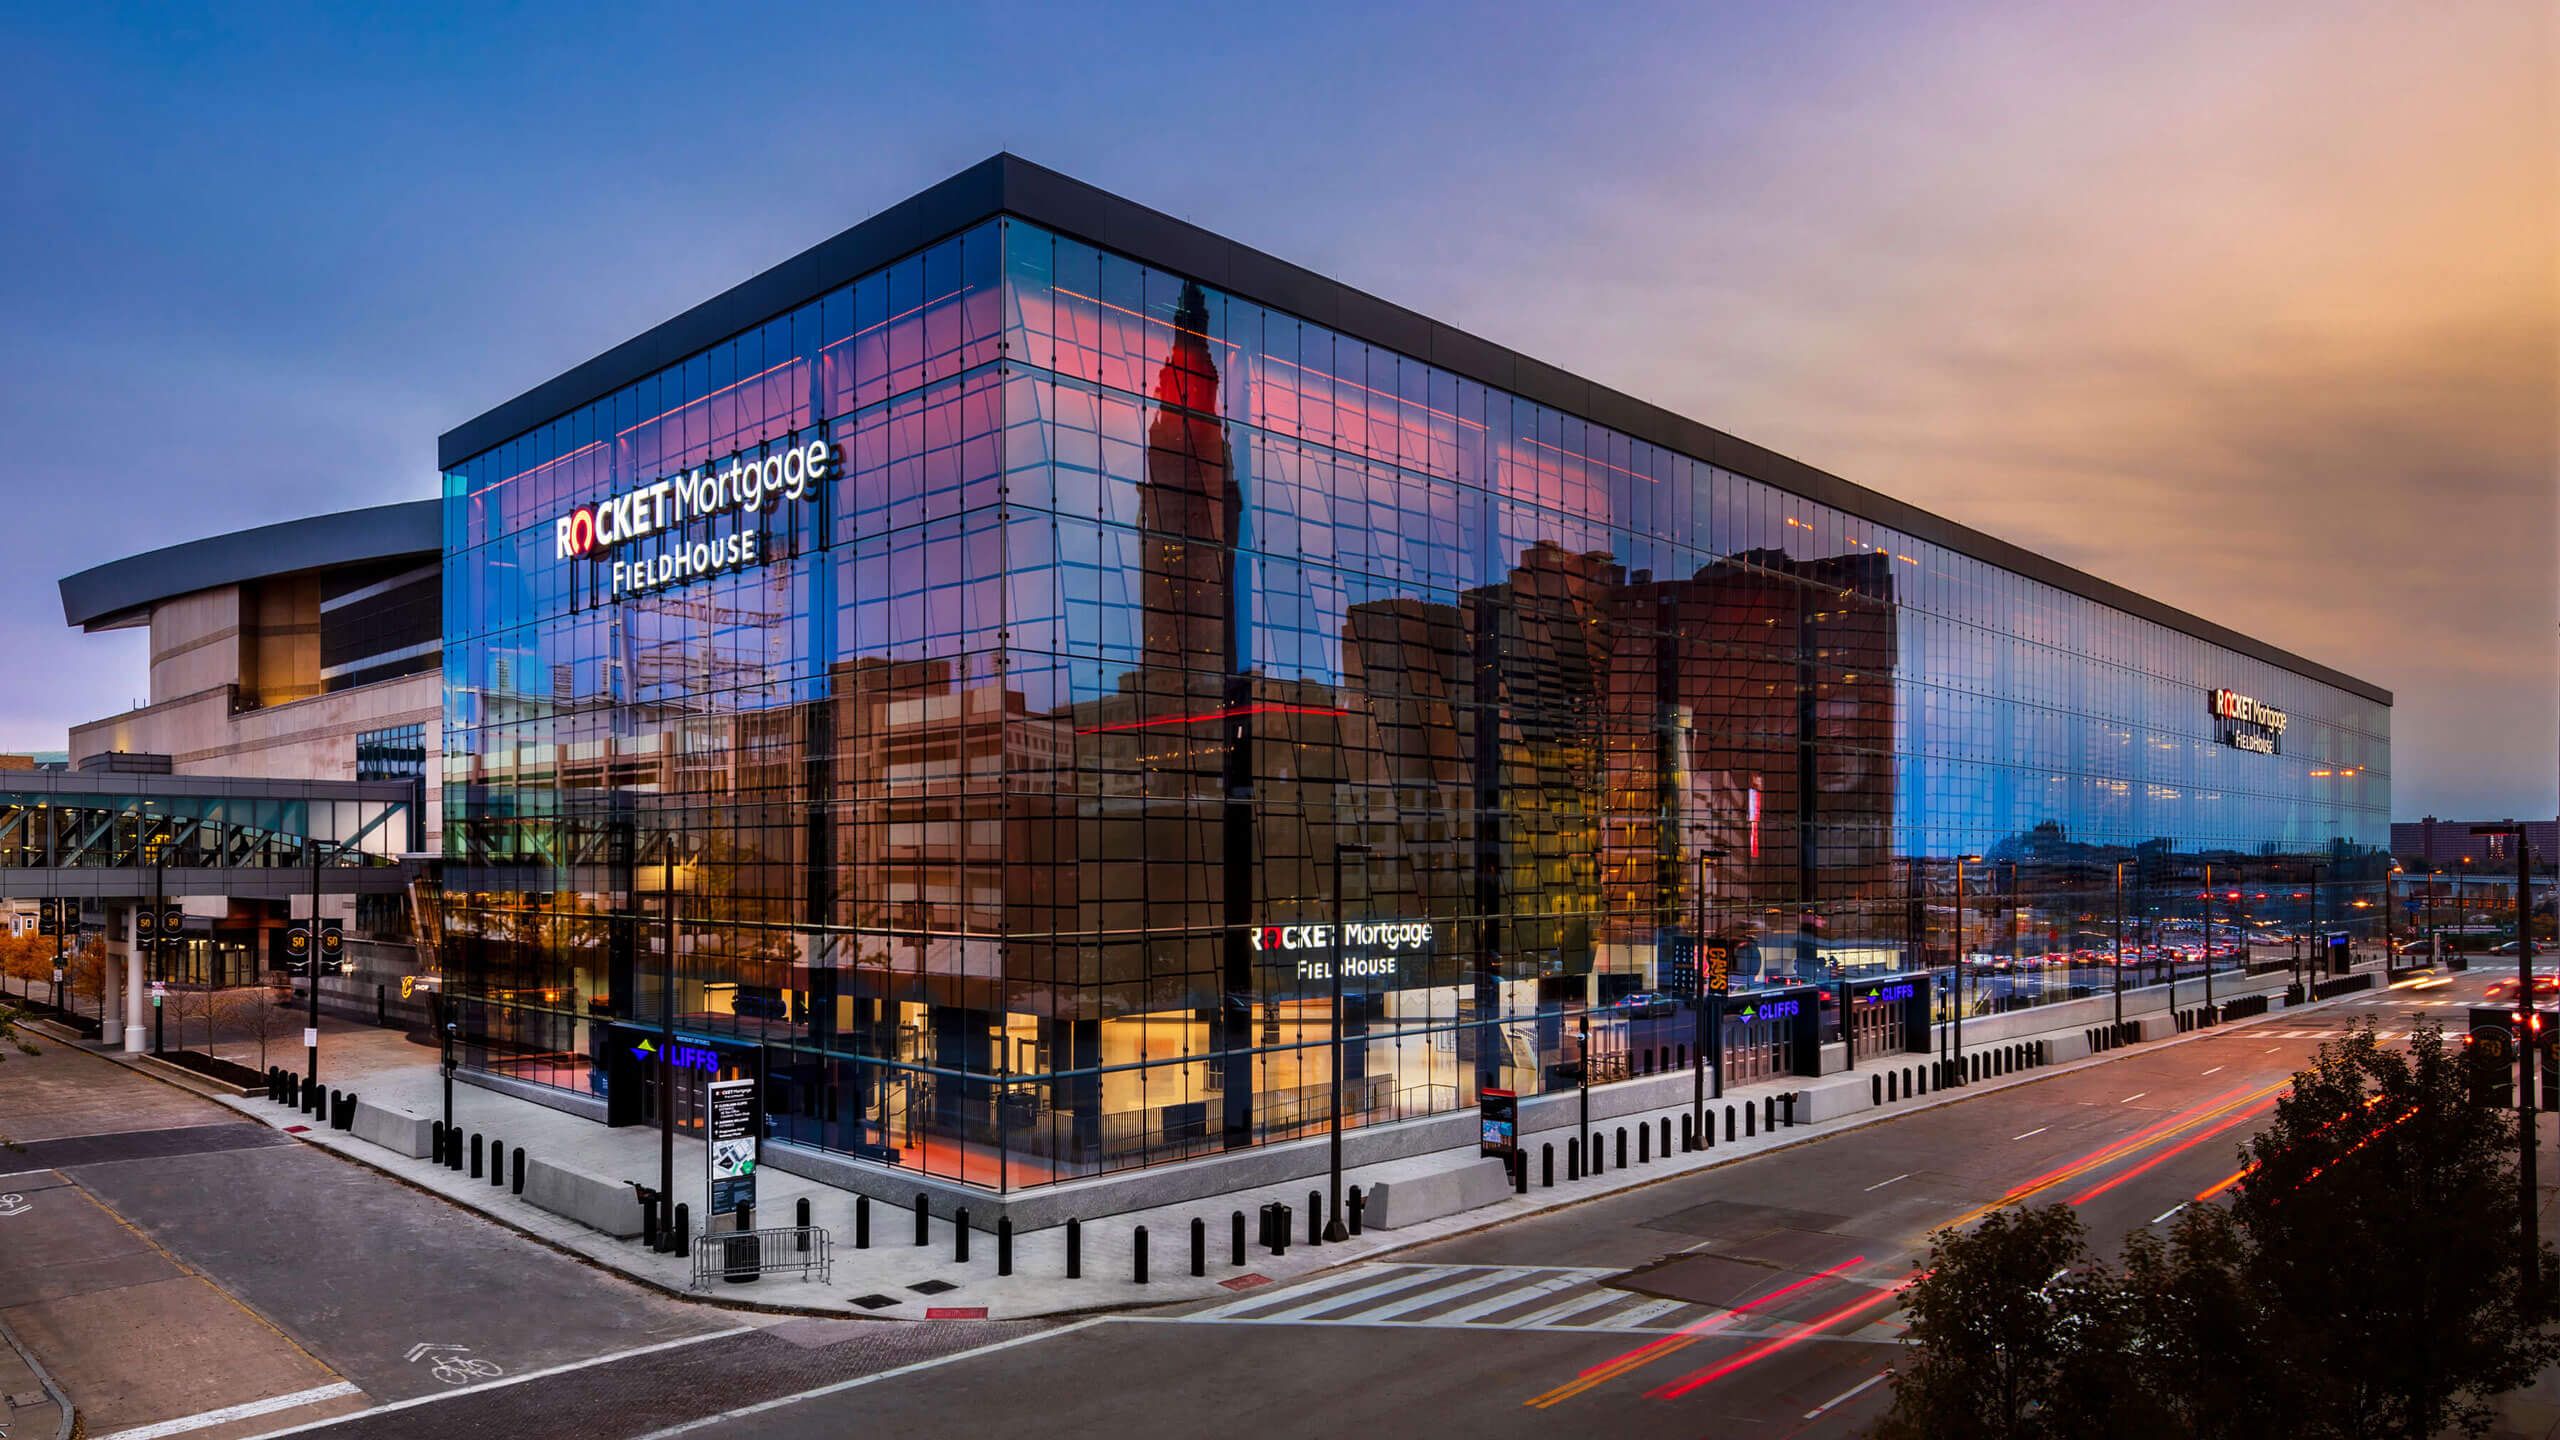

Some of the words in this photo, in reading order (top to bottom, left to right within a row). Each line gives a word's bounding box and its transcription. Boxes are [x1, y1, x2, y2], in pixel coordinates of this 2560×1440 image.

[556, 481, 673, 561] ROCKET
[675, 440, 828, 521] Mortgage
[612, 529, 757, 594] FIELDHOUSE
[2217, 690, 2253, 720] ROCKET
[2254, 701, 2287, 735] Mortgage
[2236, 730, 2273, 753] FIELDHOUSE
[140, 918, 151, 928] 50
[168, 918, 179, 928] 50
[292, 936, 305, 948] 50
[327, 936, 338, 947] 50
[1344, 923, 1433, 950] Mortgage
[1297, 957, 1396, 981] FIELHOUSE
[1708, 947, 1728, 991] CAVS
[1882, 984, 1914, 1001] CLIFFS
[1759, 1001, 1799, 1020] CLIFFS
